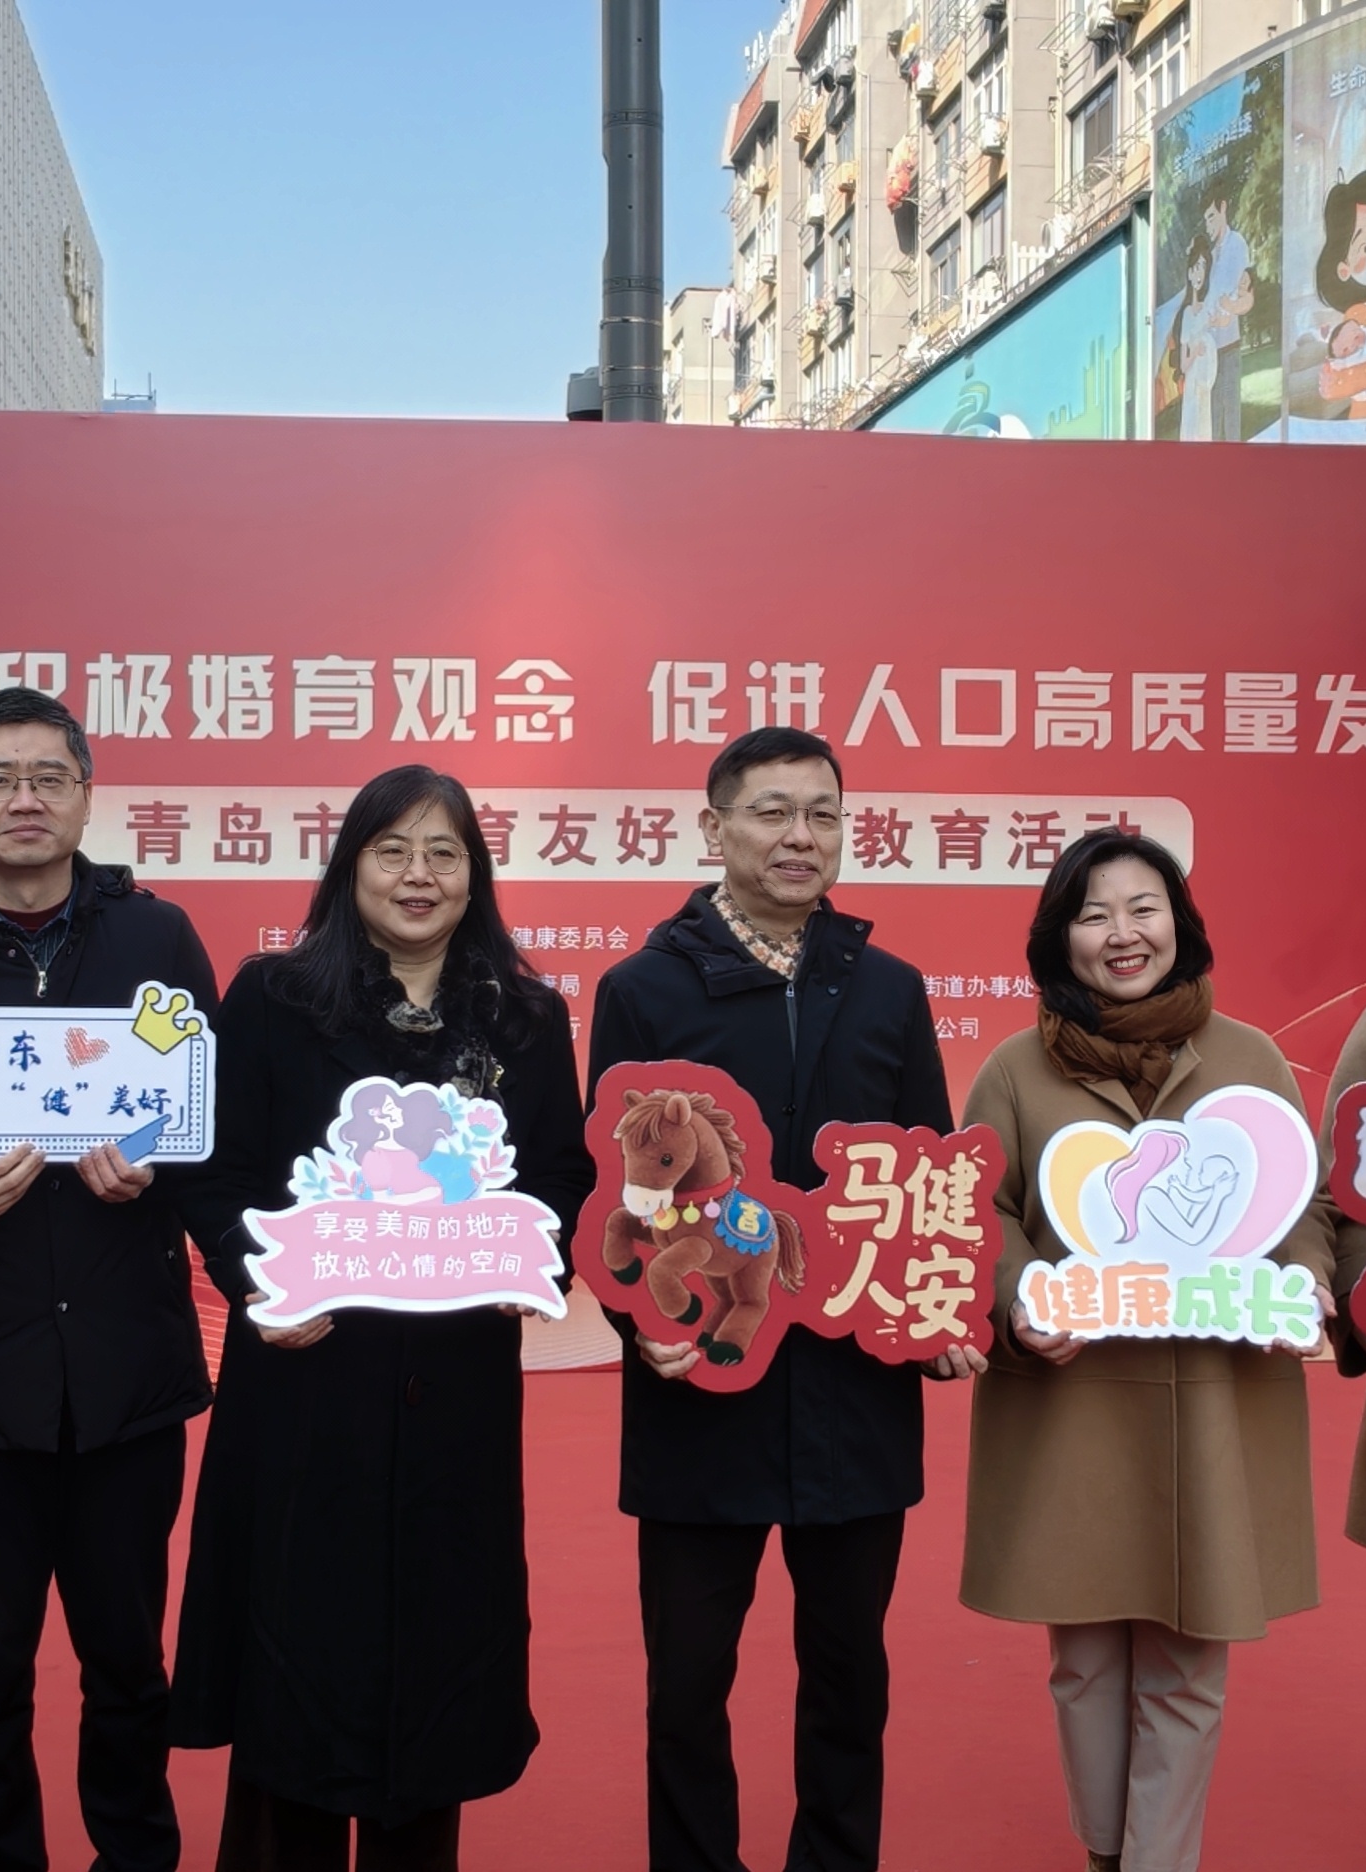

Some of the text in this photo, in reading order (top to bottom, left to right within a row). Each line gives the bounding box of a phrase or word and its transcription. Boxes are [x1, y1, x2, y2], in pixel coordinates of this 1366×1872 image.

[127, 800, 1142, 871] 青岛市育友好教育活
[510, 924, 630, 950] 健康委员会
[923, 975, 1035, 999] 街道办事处
[935, 1016, 979, 1040] 公司
[312, 1210, 519, 1243] 享受美丽的地方
[311, 1249, 523, 1281] 放松心情的空间
[1028, 1263, 1317, 1340] 健康成长
